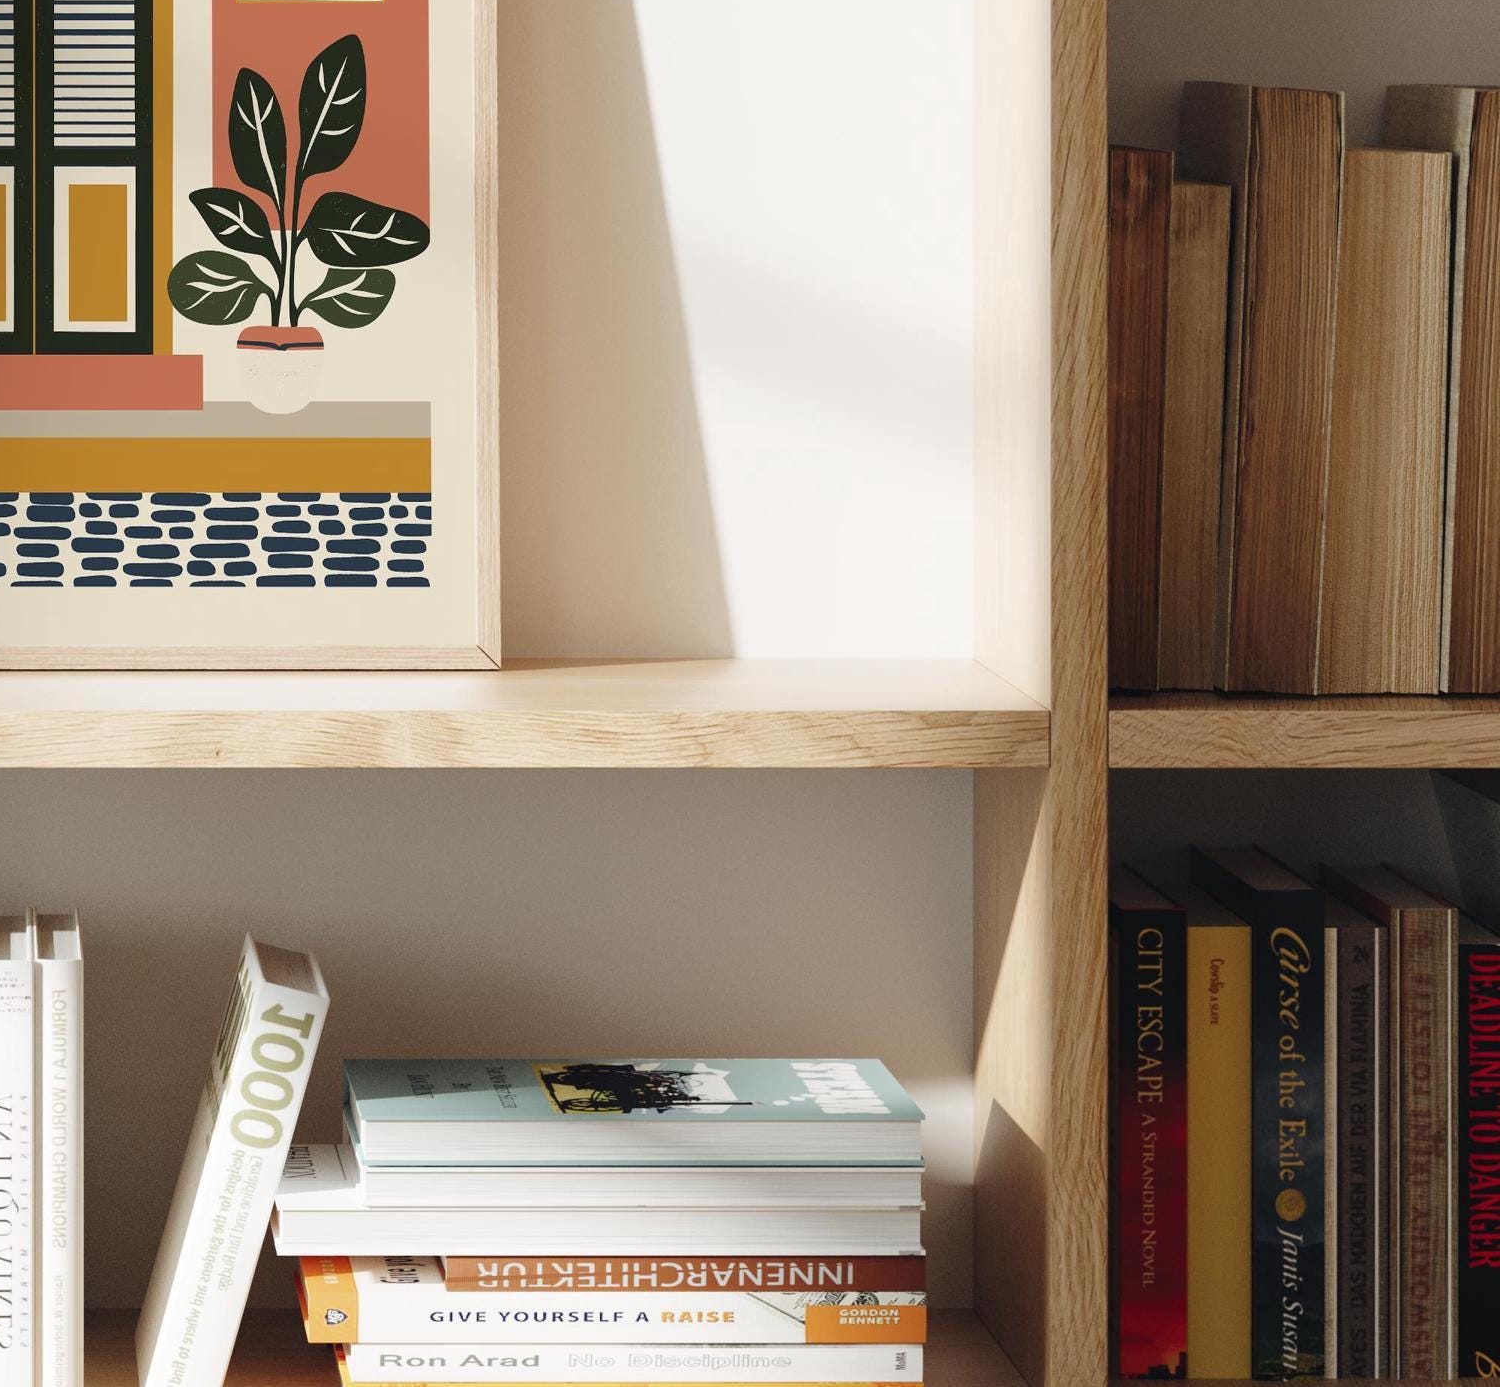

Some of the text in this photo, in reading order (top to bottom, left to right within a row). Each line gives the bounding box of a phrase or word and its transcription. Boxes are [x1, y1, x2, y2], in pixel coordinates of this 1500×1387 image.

[1208, 958, 1224, 995] Cowslip
[1137, 927, 1163, 1103] CITY ESCAPE
[1270, 927, 1311, 1181] Curse of the Exile
[1142, 1114, 1156, 1124] A
[1468, 954, 1500, 1269] DEADLINE TO DANGER
[1278, 1227, 1304, 1290] Janis
[477, 1262, 855, 1287] INNENARCHITEKTUR
[429, 1310, 735, 1324] GIVE YOURSELF A RAISE
[839, 1309, 899, 1317] GORDON
[379, 1353, 792, 1372] Ron Arad No Discipline
